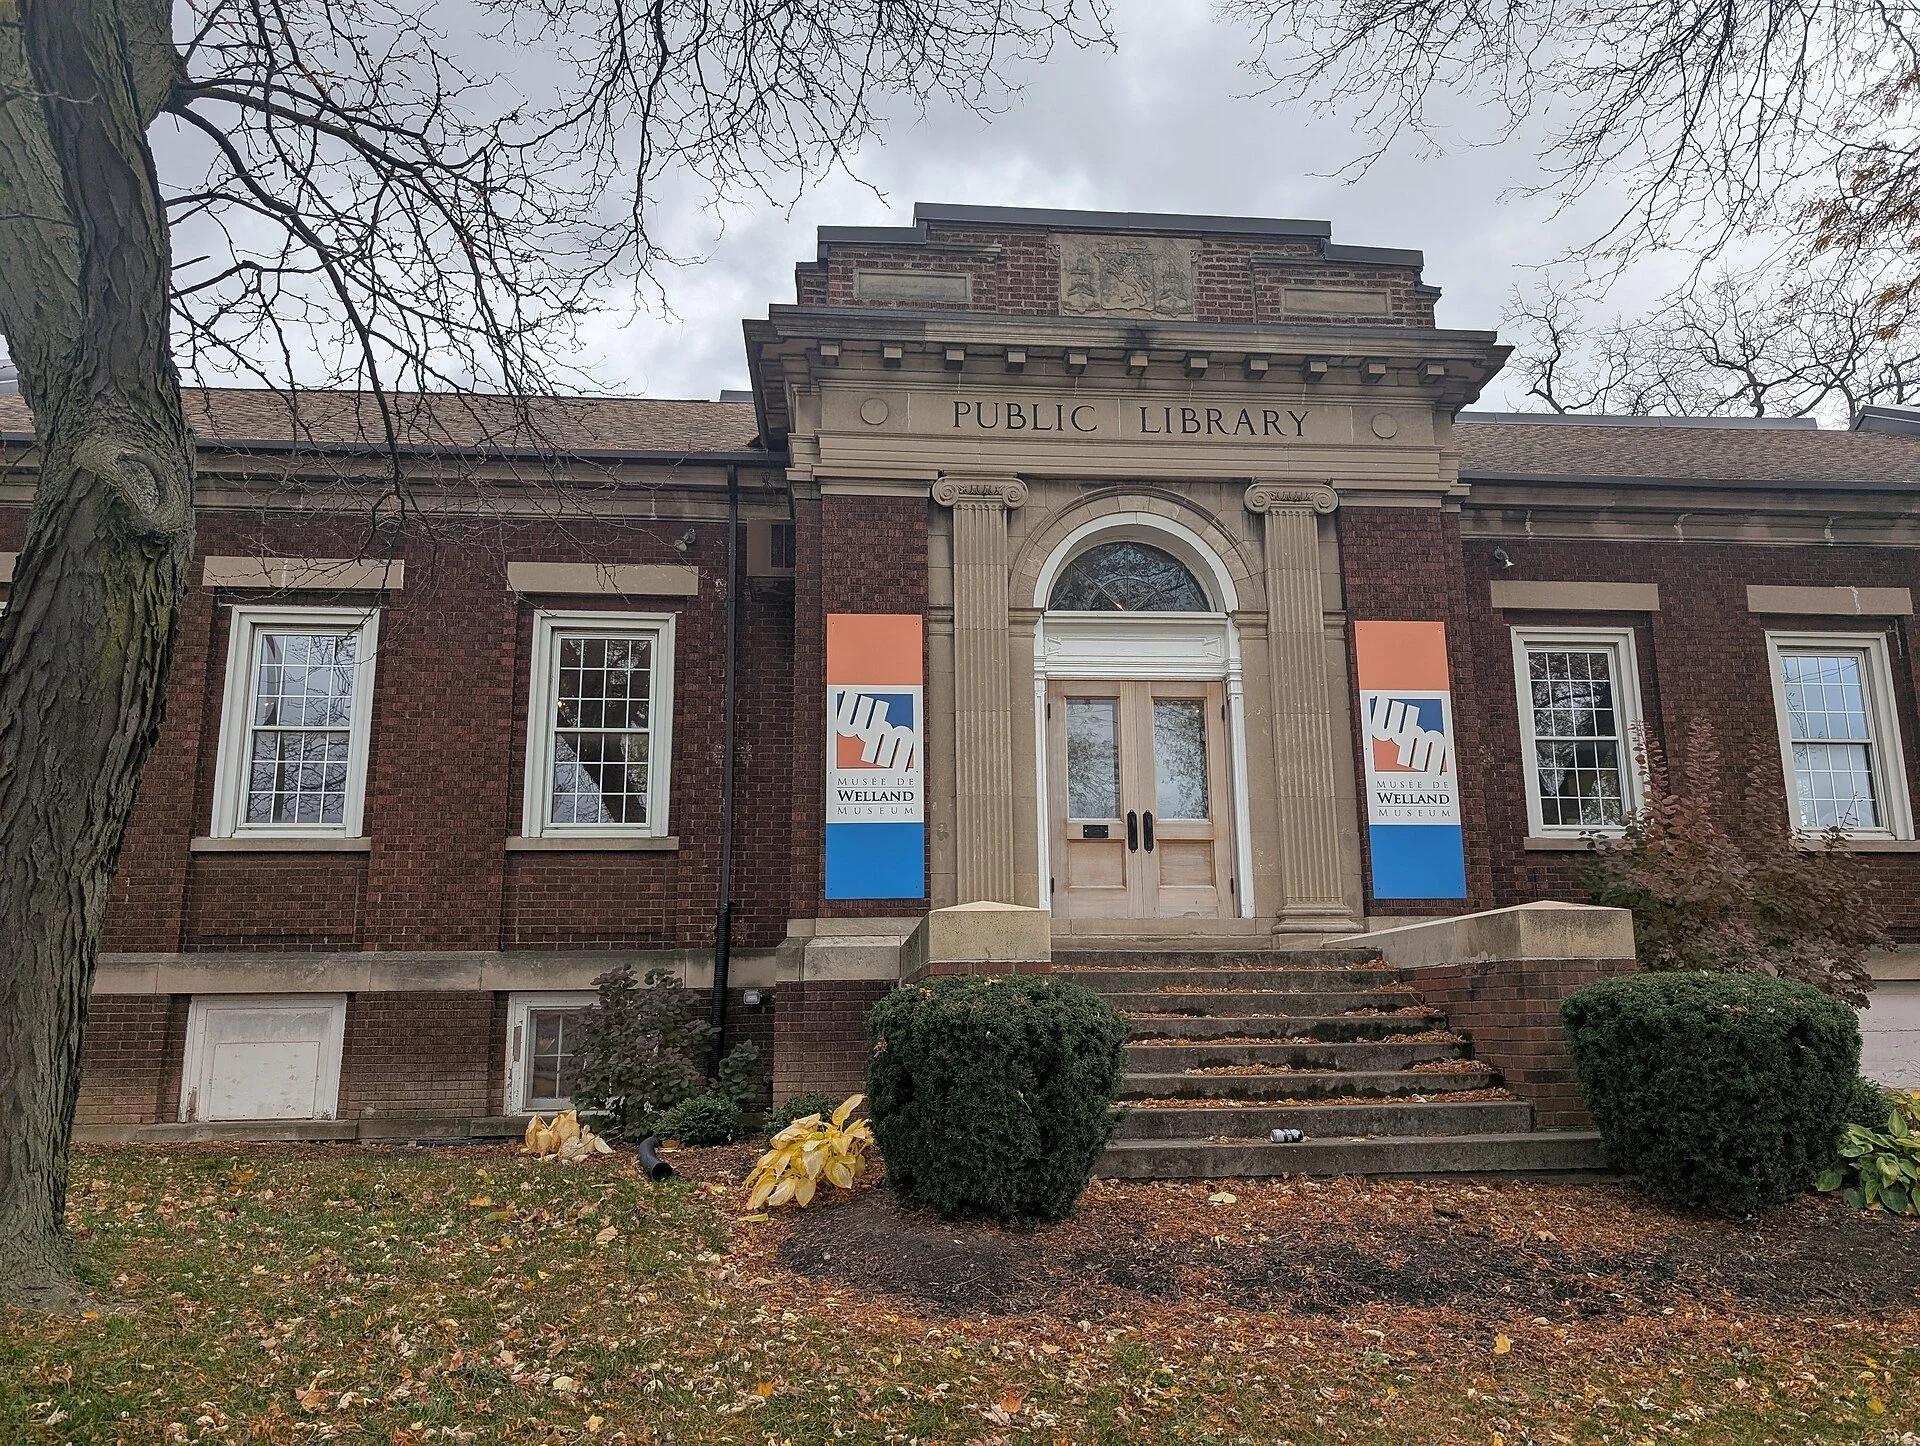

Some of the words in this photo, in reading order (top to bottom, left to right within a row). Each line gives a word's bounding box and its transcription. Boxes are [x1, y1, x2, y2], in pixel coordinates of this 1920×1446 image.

[953, 401, 1098, 432] PUBLIC
[1139, 406, 1311, 437] LIBRARY
[897, 778, 914, 786] DE
[1433, 781, 1449, 789] DE
[837, 789, 914, 802] WELLAND
[1377, 792, 1450, 805] WELLAND
[837, 807, 914, 815] MUSEUM
[1378, 809, 1451, 817] MUSEUM
